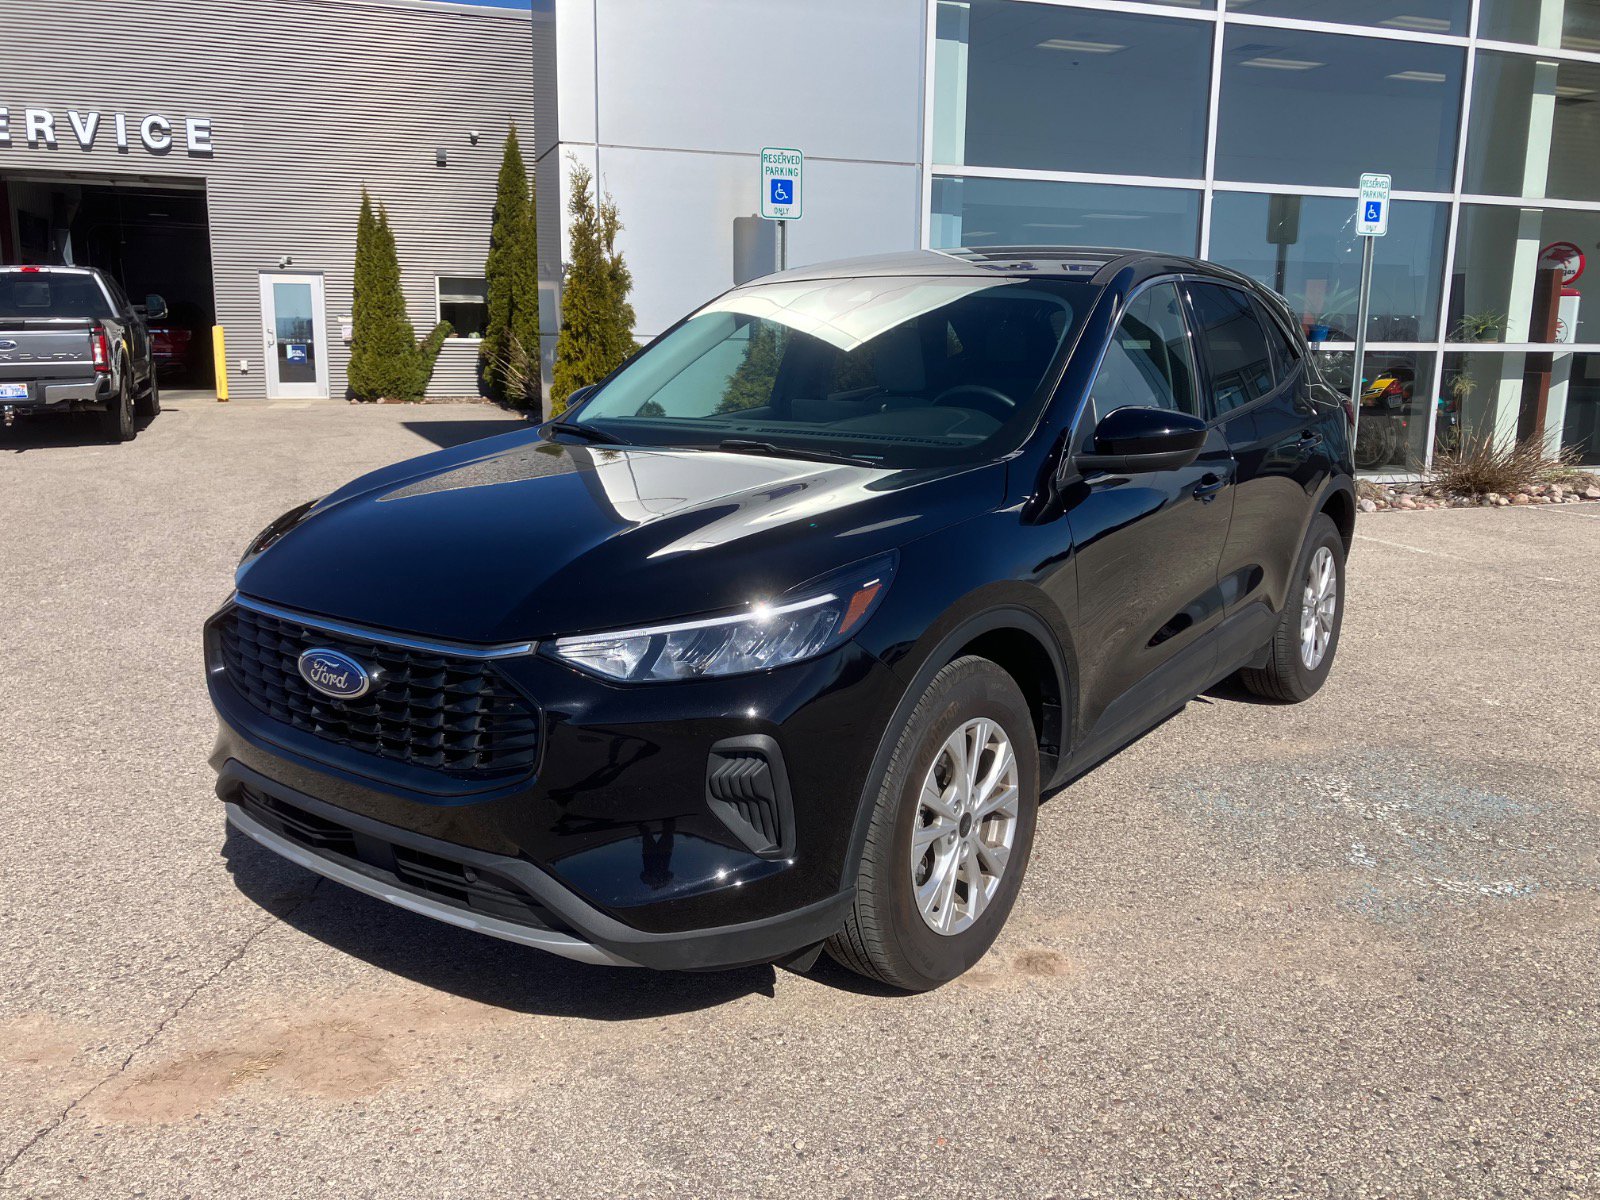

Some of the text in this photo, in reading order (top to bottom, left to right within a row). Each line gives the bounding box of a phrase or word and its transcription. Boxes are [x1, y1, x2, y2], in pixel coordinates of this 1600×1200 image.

[763, 154, 801, 165] RESERVED
[765, 166, 799, 177] PARKING
[1361, 179, 1389, 190] RESERVED
[1363, 190, 1387, 200] PARKING
[773, 207, 790, 215] ONLY
[310, 658, 348, 689] Ford
